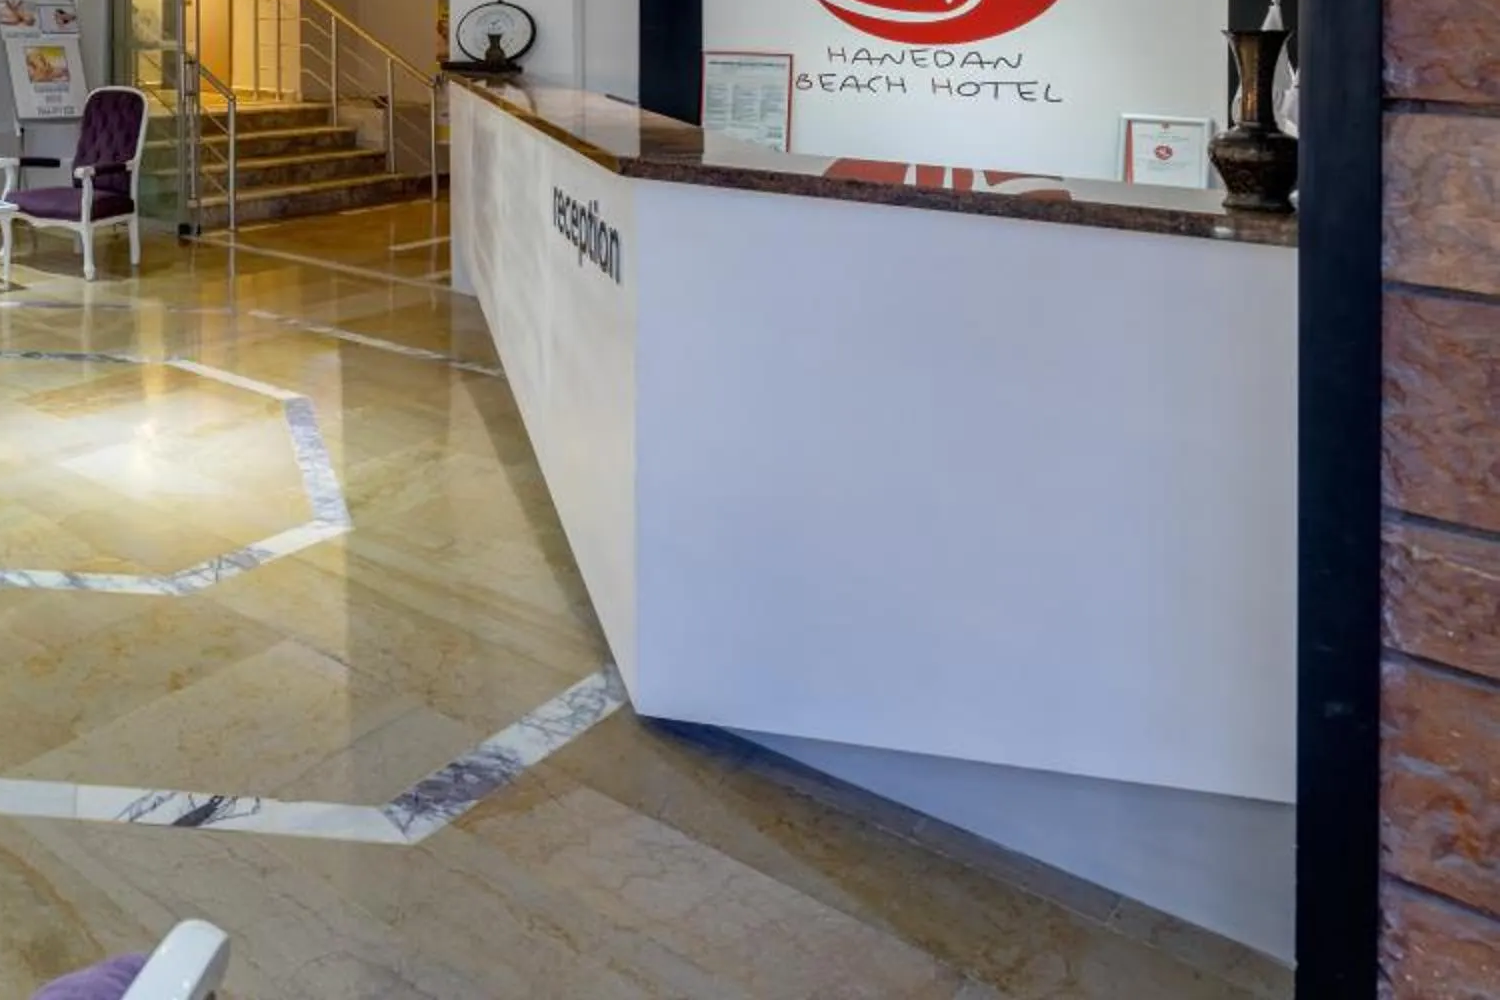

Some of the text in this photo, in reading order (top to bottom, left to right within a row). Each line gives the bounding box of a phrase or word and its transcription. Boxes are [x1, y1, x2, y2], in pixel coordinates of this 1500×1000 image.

[827, 45, 1024, 70] HANEDAN
[795, 72, 1063, 103] BEACH HOTEL
[553, 186, 621, 285] reception
